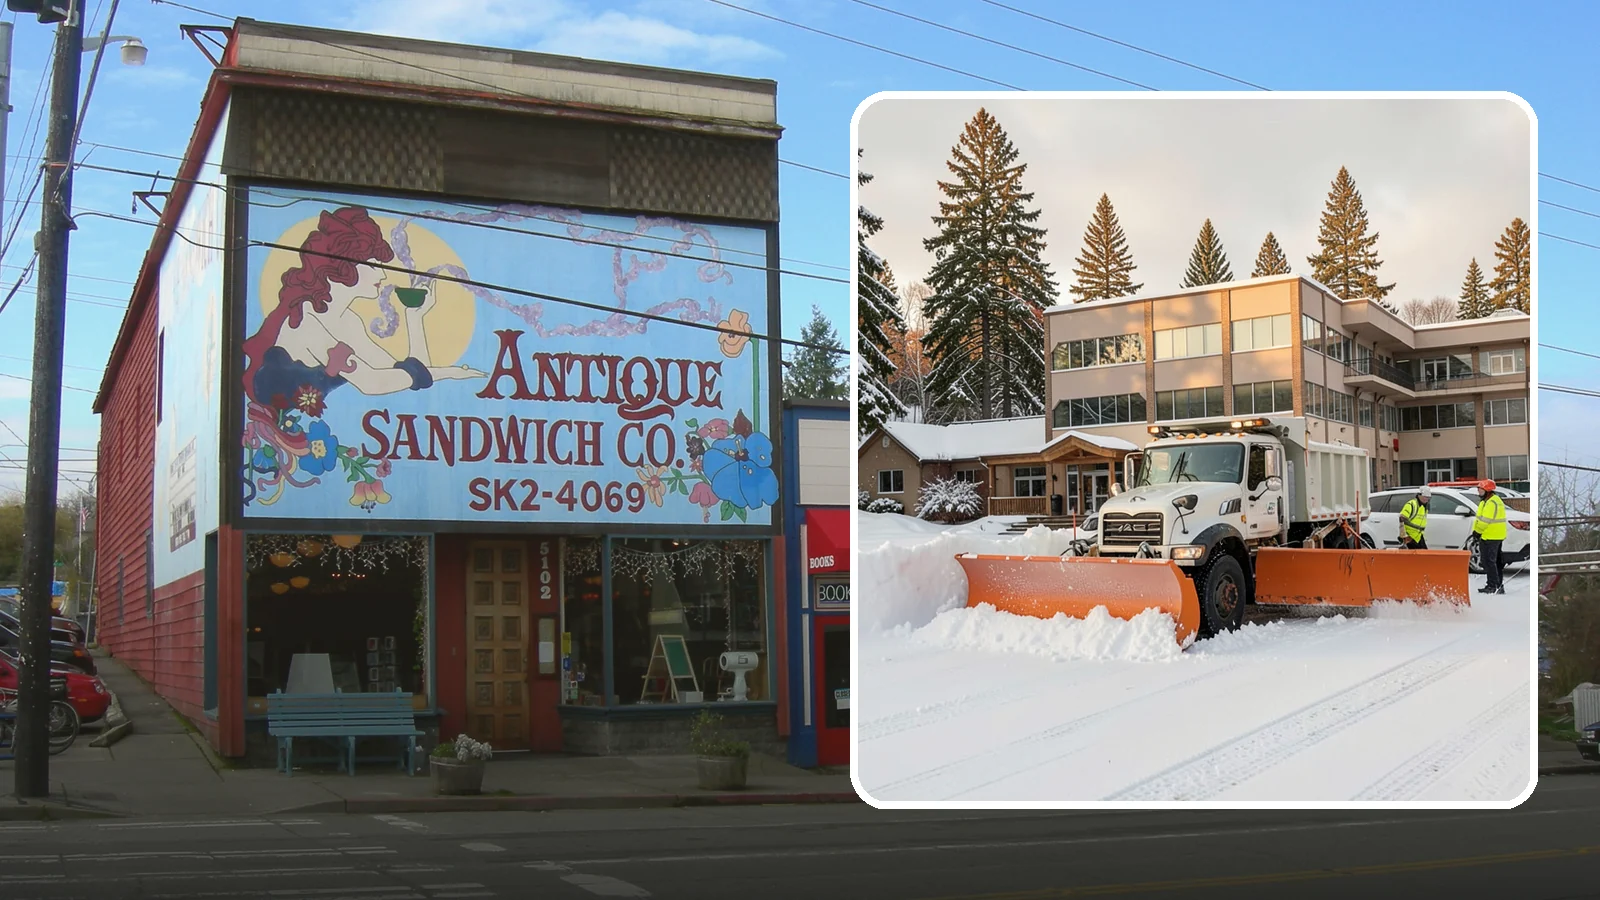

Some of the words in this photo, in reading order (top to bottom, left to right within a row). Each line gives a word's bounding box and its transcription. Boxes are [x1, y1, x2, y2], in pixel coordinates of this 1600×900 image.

[475, 329, 723, 420] ANTIQUE
[361, 408, 606, 468] SANDWICH
[616, 421, 686, 469] CO.
[468, 477, 647, 513] SK2-4069
[540, 541, 551, 600] 5102
[809, 555, 835, 569] BOOKS
